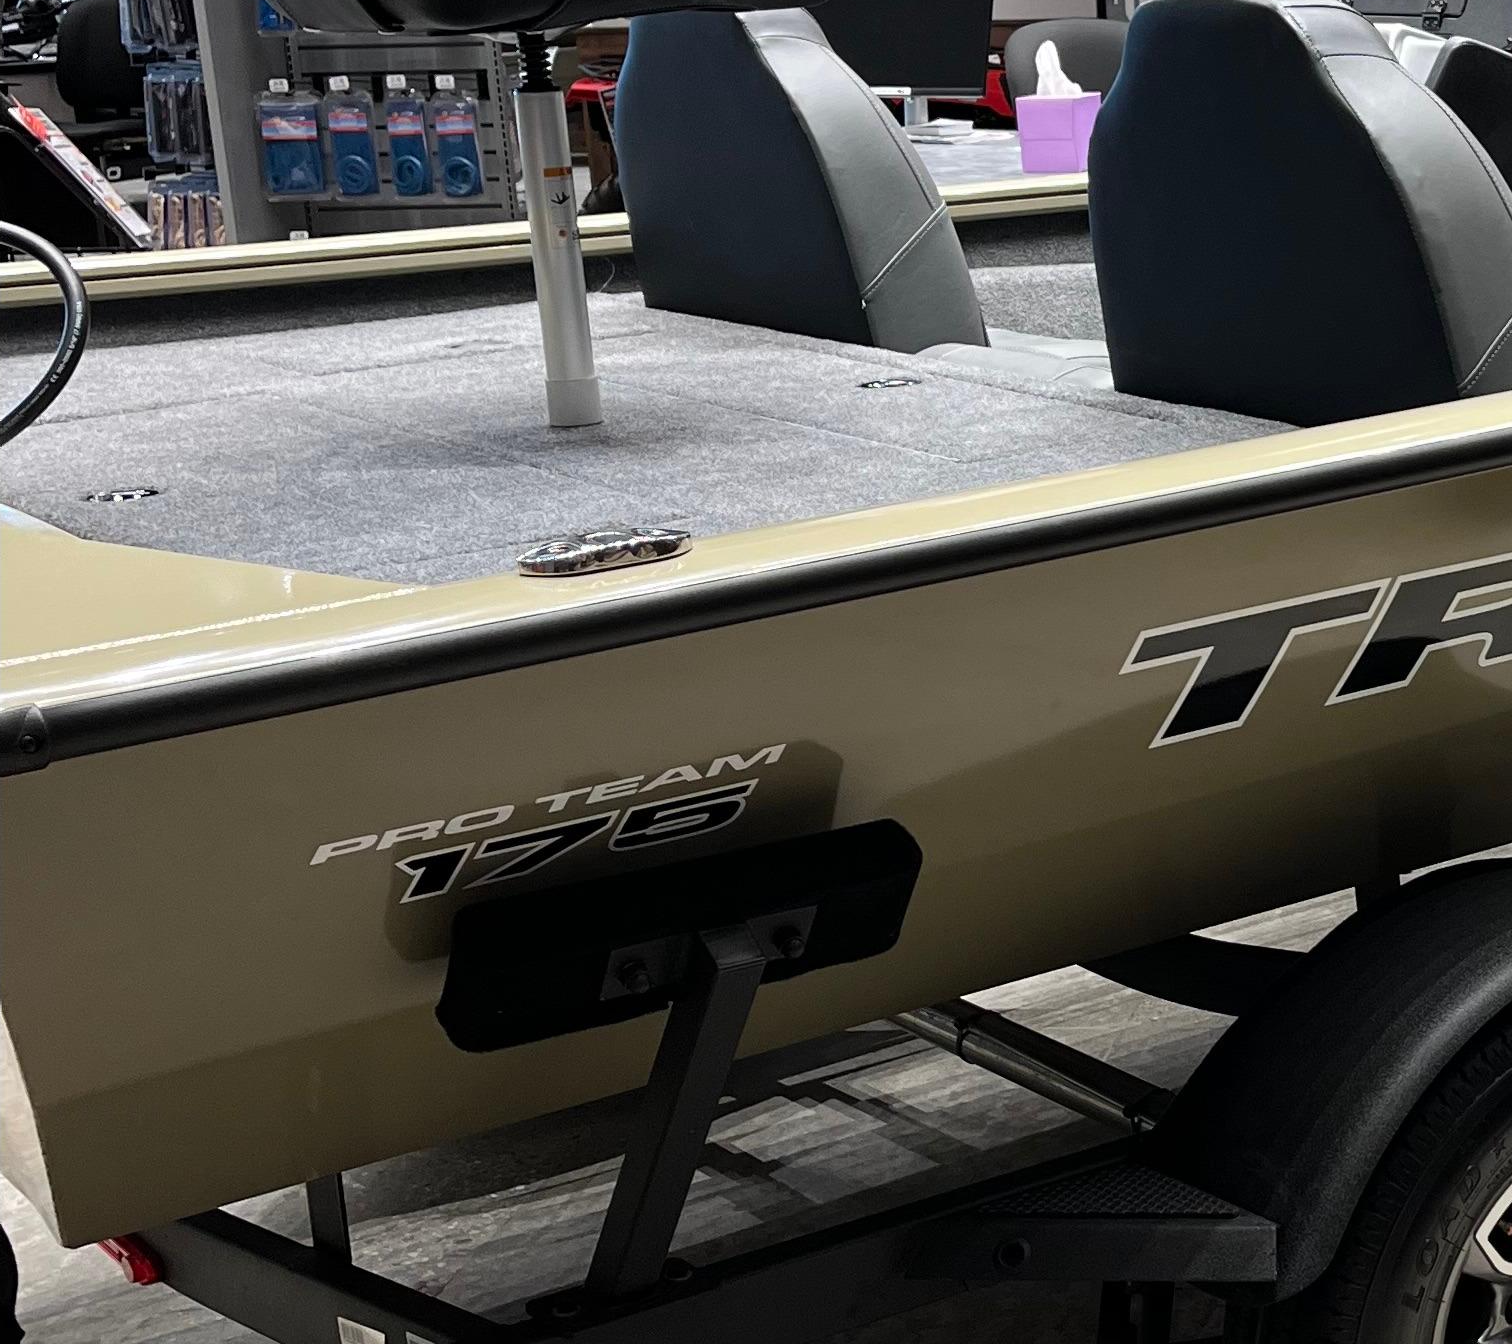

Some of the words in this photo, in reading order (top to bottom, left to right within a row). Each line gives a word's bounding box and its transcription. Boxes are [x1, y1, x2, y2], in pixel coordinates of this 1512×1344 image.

[309, 803, 516, 866] PRO
[535, 742, 787, 815] TEAM
[394, 777, 760, 905] 175
